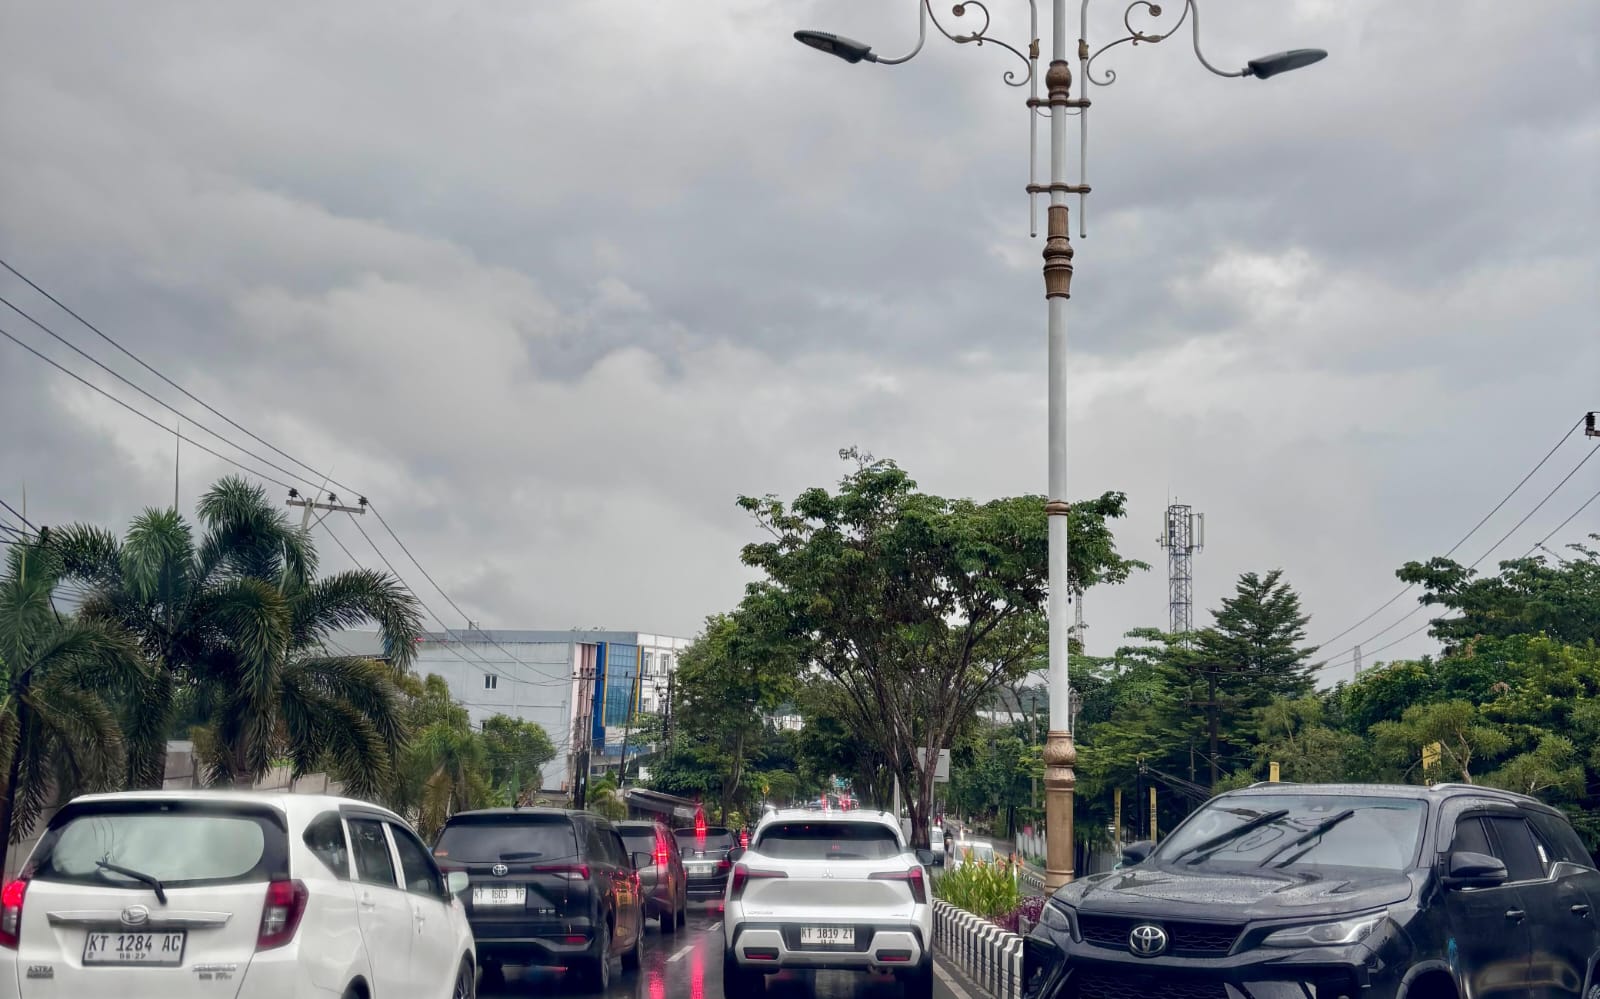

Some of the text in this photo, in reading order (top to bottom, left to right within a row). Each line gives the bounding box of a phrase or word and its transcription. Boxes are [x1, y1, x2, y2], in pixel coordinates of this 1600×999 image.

[801, 928, 812, 938] KT
[89, 934, 181, 952] KT 1284 AC
